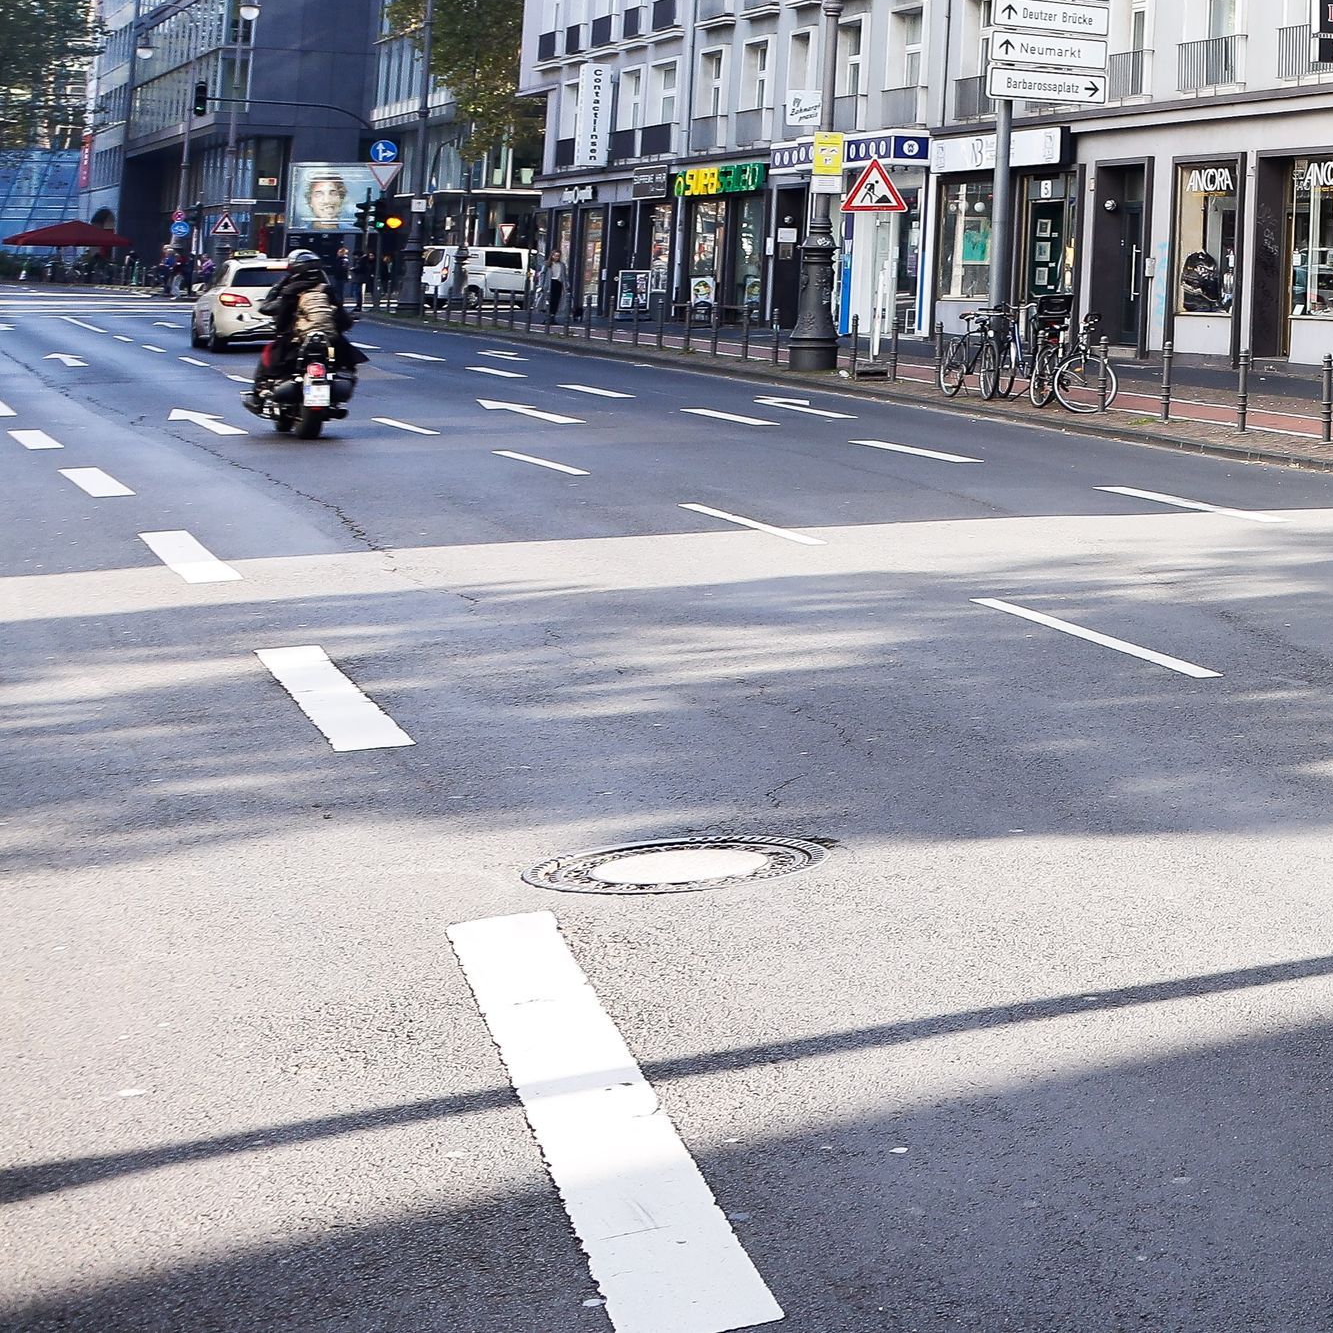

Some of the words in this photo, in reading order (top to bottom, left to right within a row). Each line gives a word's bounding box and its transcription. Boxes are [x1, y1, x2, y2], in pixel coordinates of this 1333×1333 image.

[1022, 8, 1057, 22] Deutzer
[1062, 12, 1093, 25] Brücke
[1020, 42, 1081, 58] Neumarkt
[1006, 77, 1080, 94] Barbarossaplatz
[589, 69, 603, 161] Contactlinsen
[1186, 168, 1234, 192] ANCORA
[1042, 183, 1049, 196] 5
